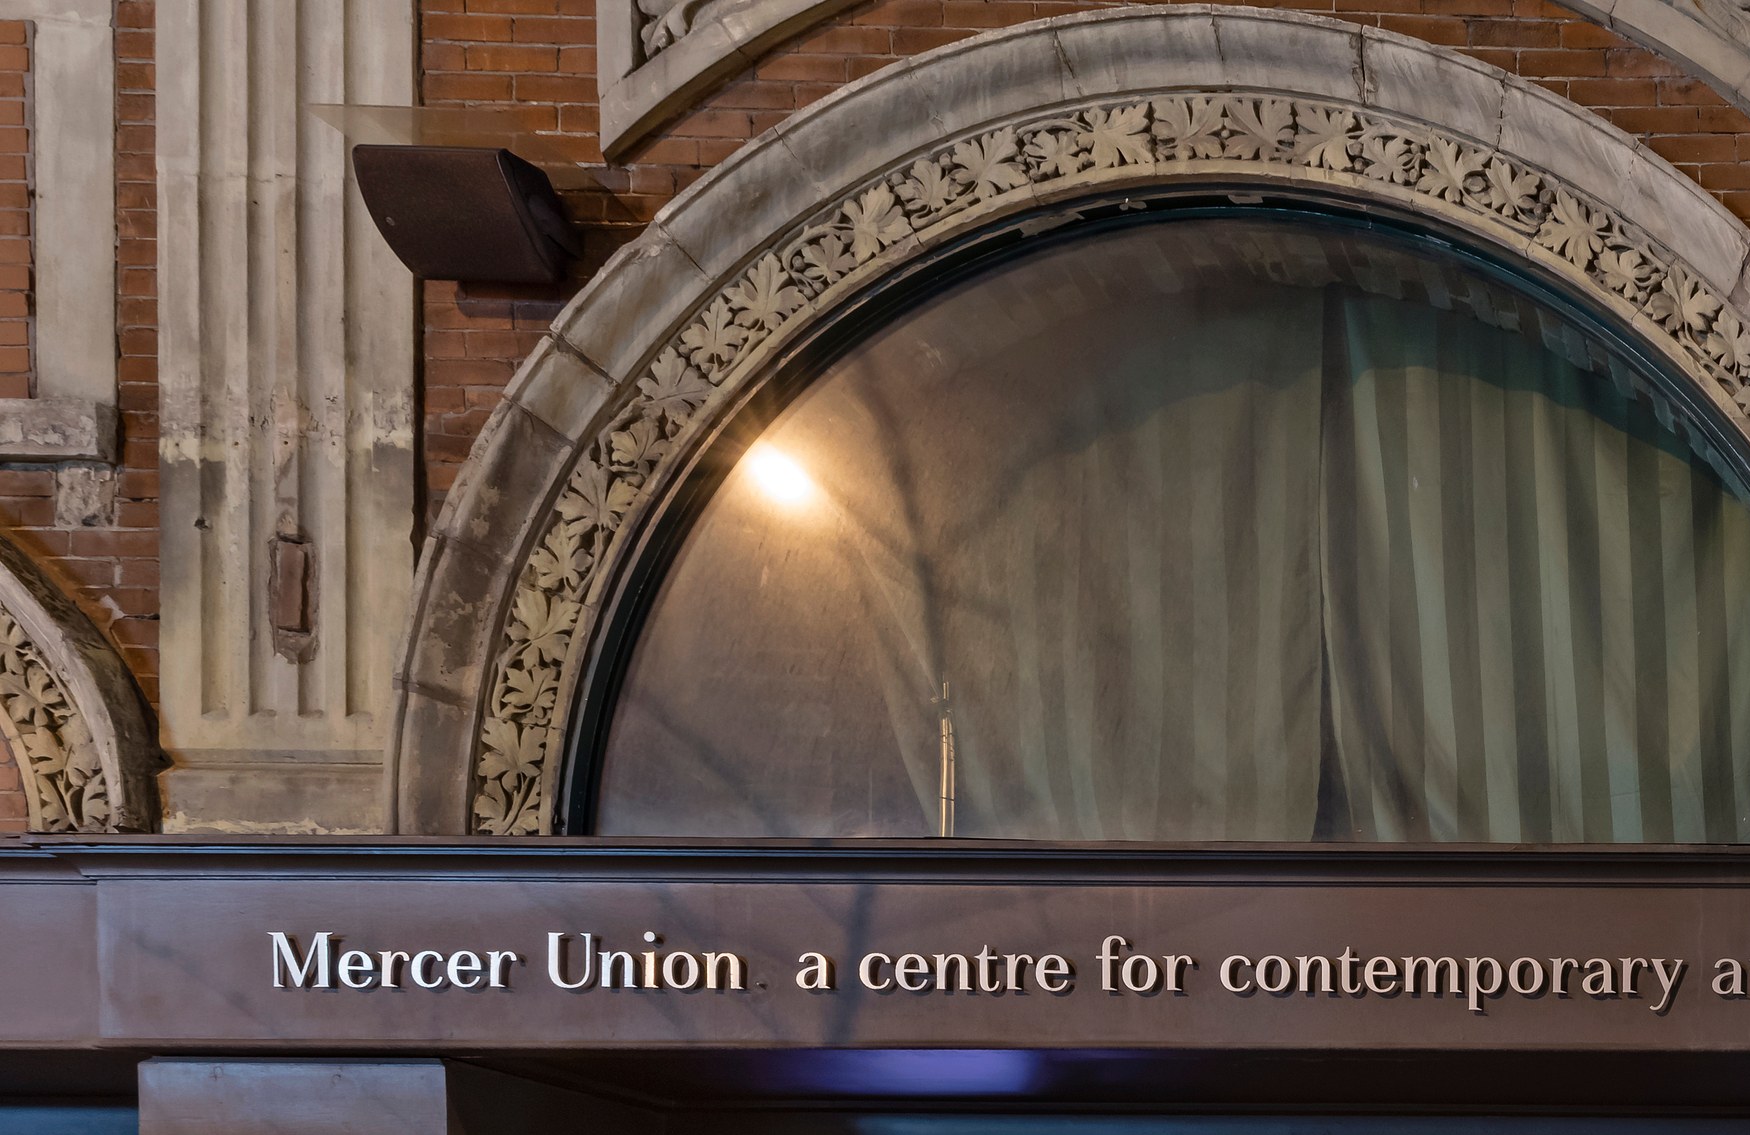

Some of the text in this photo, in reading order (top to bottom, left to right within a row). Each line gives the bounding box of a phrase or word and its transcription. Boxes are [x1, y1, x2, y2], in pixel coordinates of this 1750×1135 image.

[267, 931, 517, 990] Mercer
[548, 931, 743, 990] Union
[795, 952, 829, 991] a
[859, 944, 1071, 992] centre
[1096, 935, 1193, 992] for
[1219, 947, 1684, 1012] contemporary
